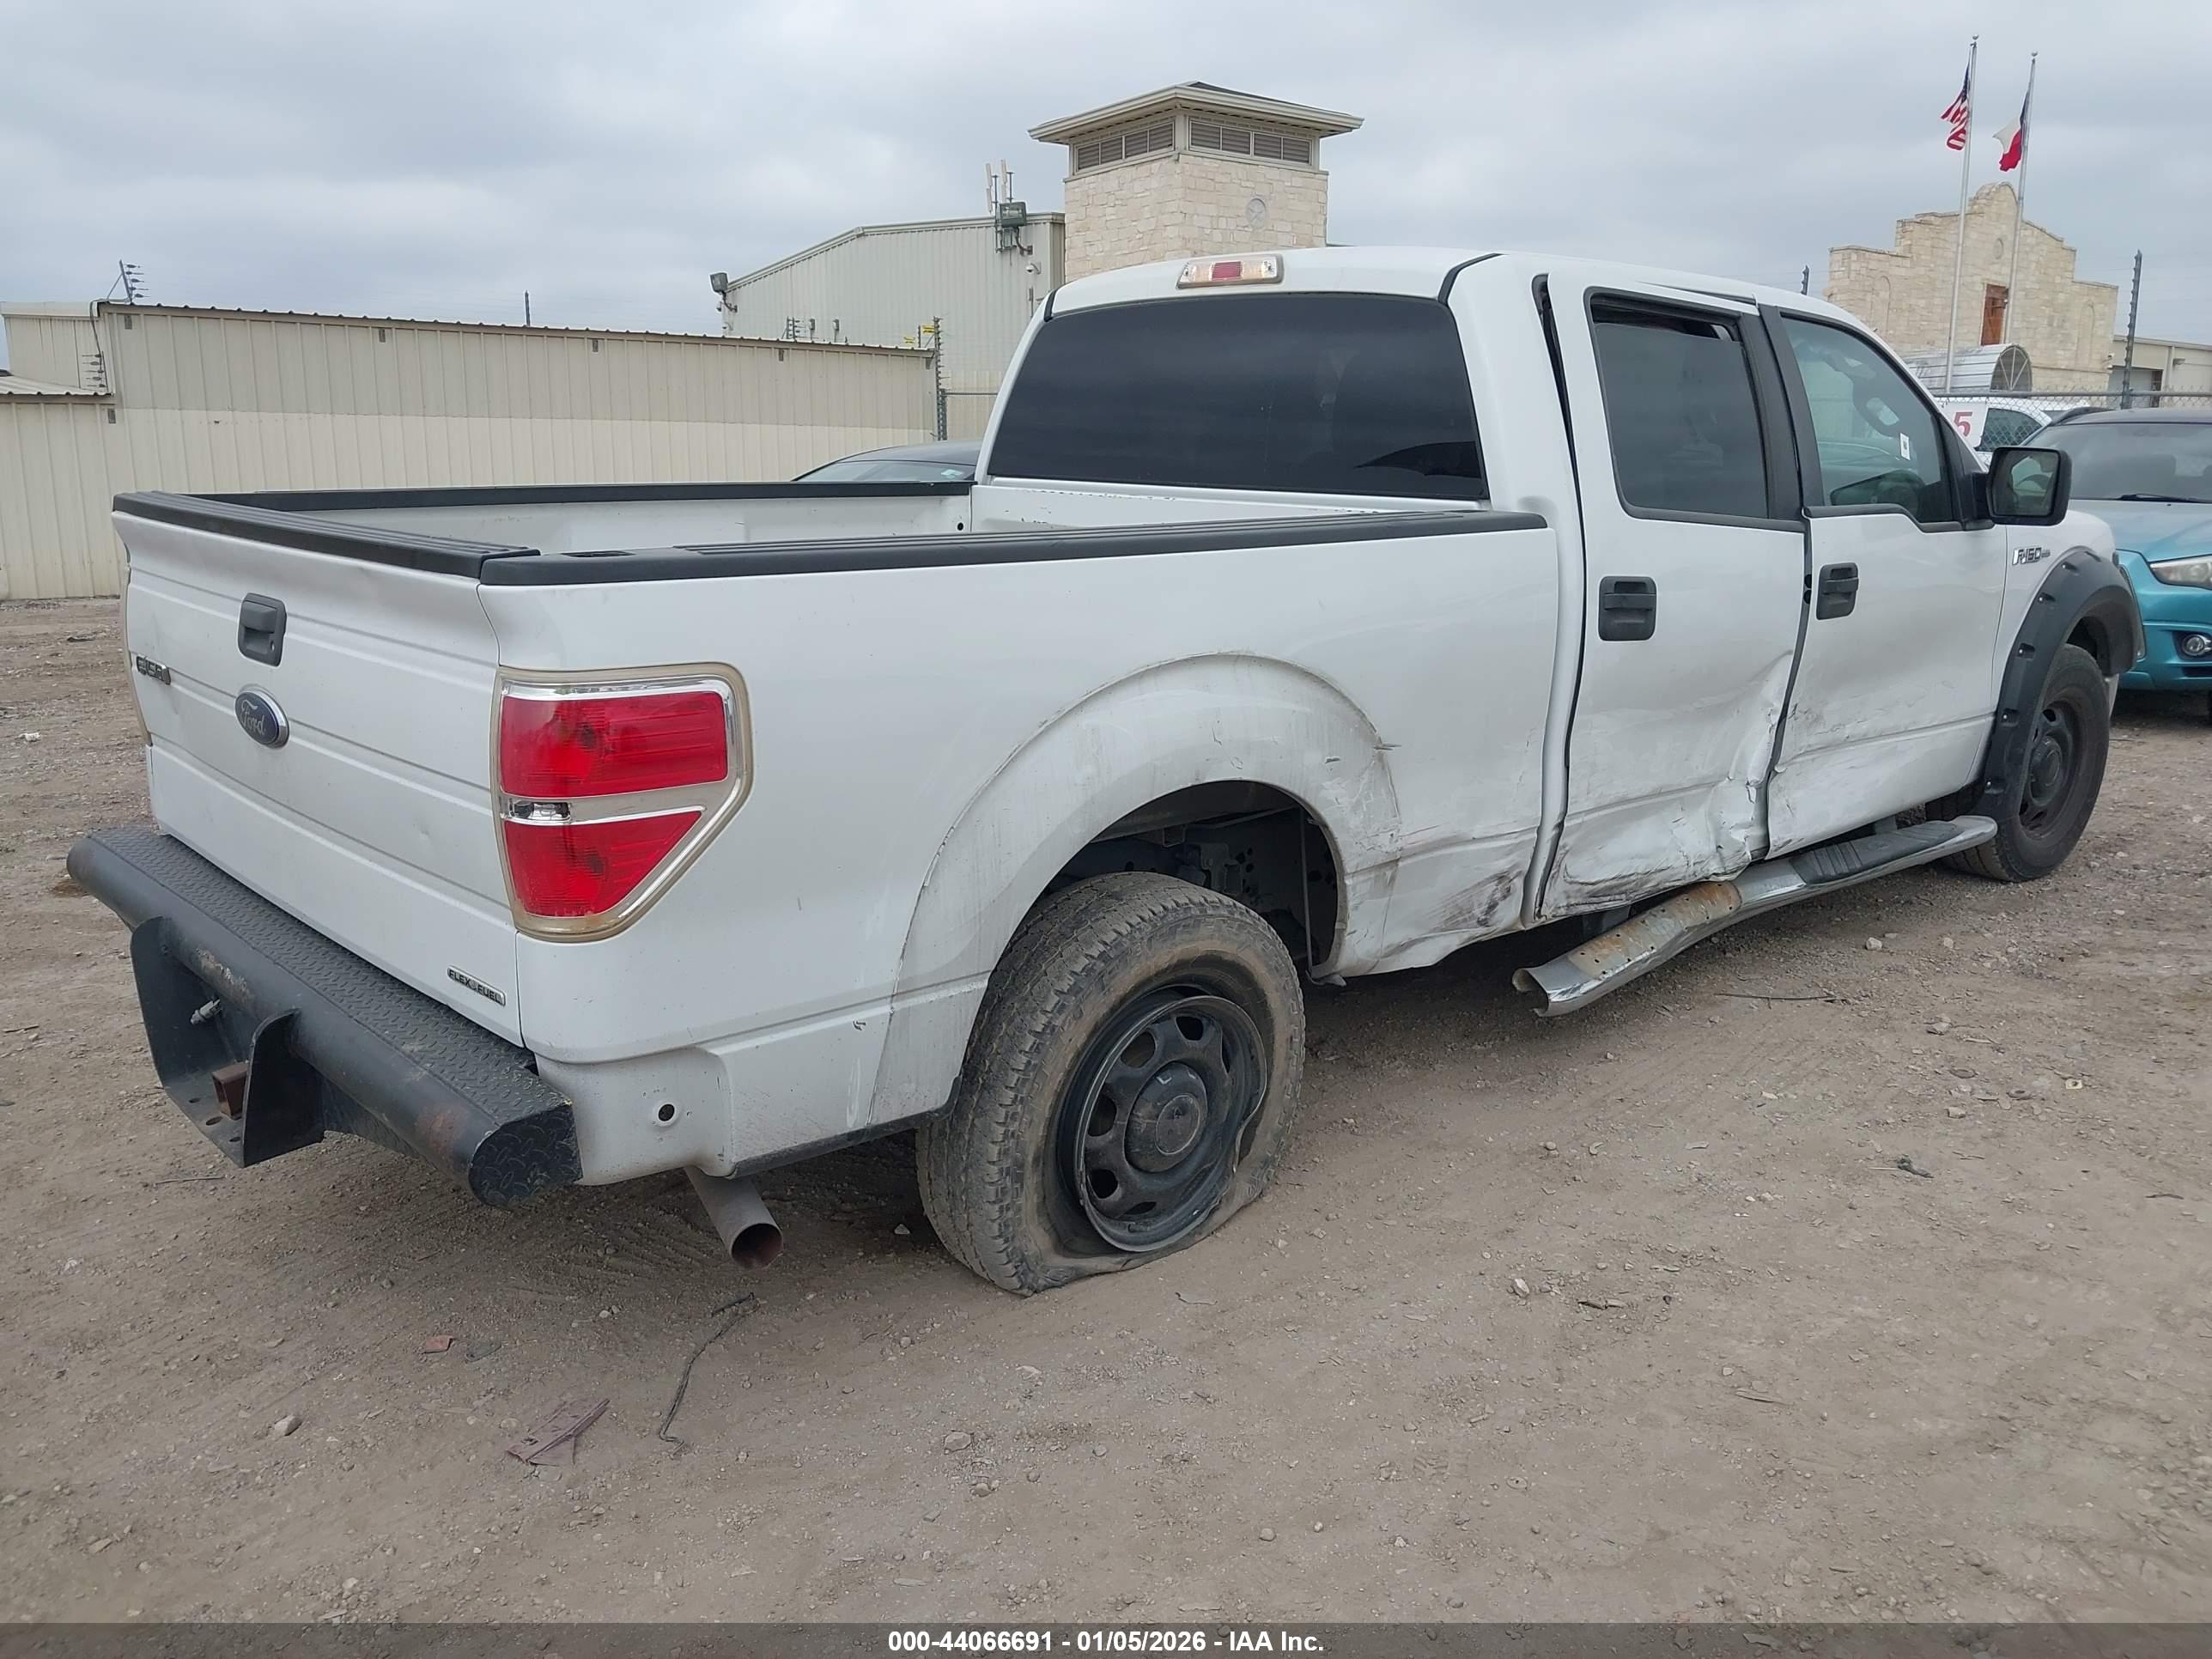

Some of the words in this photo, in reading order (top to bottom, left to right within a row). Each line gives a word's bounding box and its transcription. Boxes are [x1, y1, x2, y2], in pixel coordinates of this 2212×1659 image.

[240, 699, 266, 736] Ford
[449, 969, 471, 988] FLEX
[477, 983, 503, 1006] FUEL
